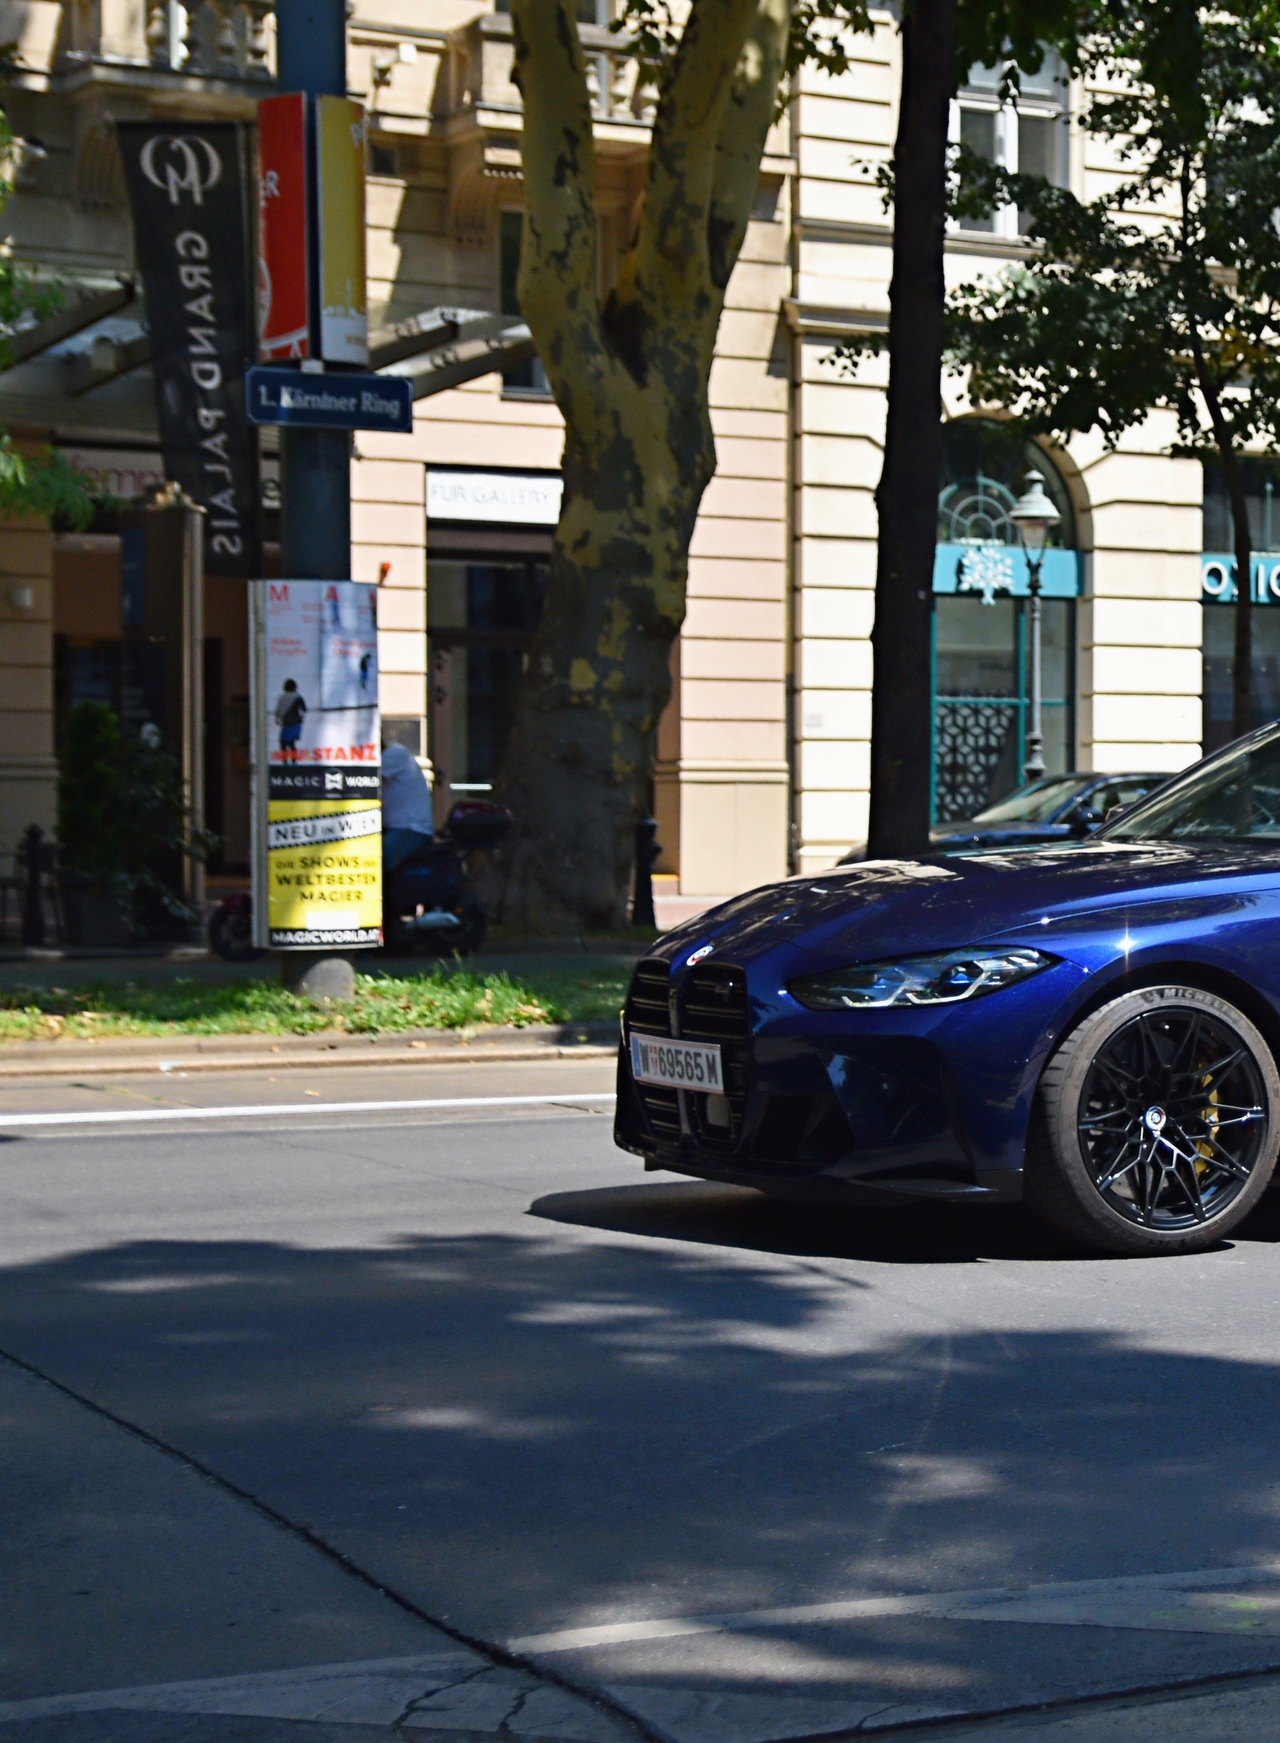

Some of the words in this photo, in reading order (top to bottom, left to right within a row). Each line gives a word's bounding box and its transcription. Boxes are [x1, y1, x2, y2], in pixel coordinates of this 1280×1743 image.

[361, 391, 400, 420] Ring
[430, 483, 467, 503] FUR
[471, 486, 550, 506] GALLERY
[270, 776, 320, 787] MAGIC
[345, 776, 379, 788] WORLD
[275, 823, 317, 841] NEU
[300, 856, 360, 869] SHOWS
[276, 873, 377, 886] WELTBESTEN
[300, 890, 364, 902] MAGIER
[640, 1043, 649, 1074] W
[658, 1046, 704, 1082] 69565
[706, 1053, 718, 1085] M
